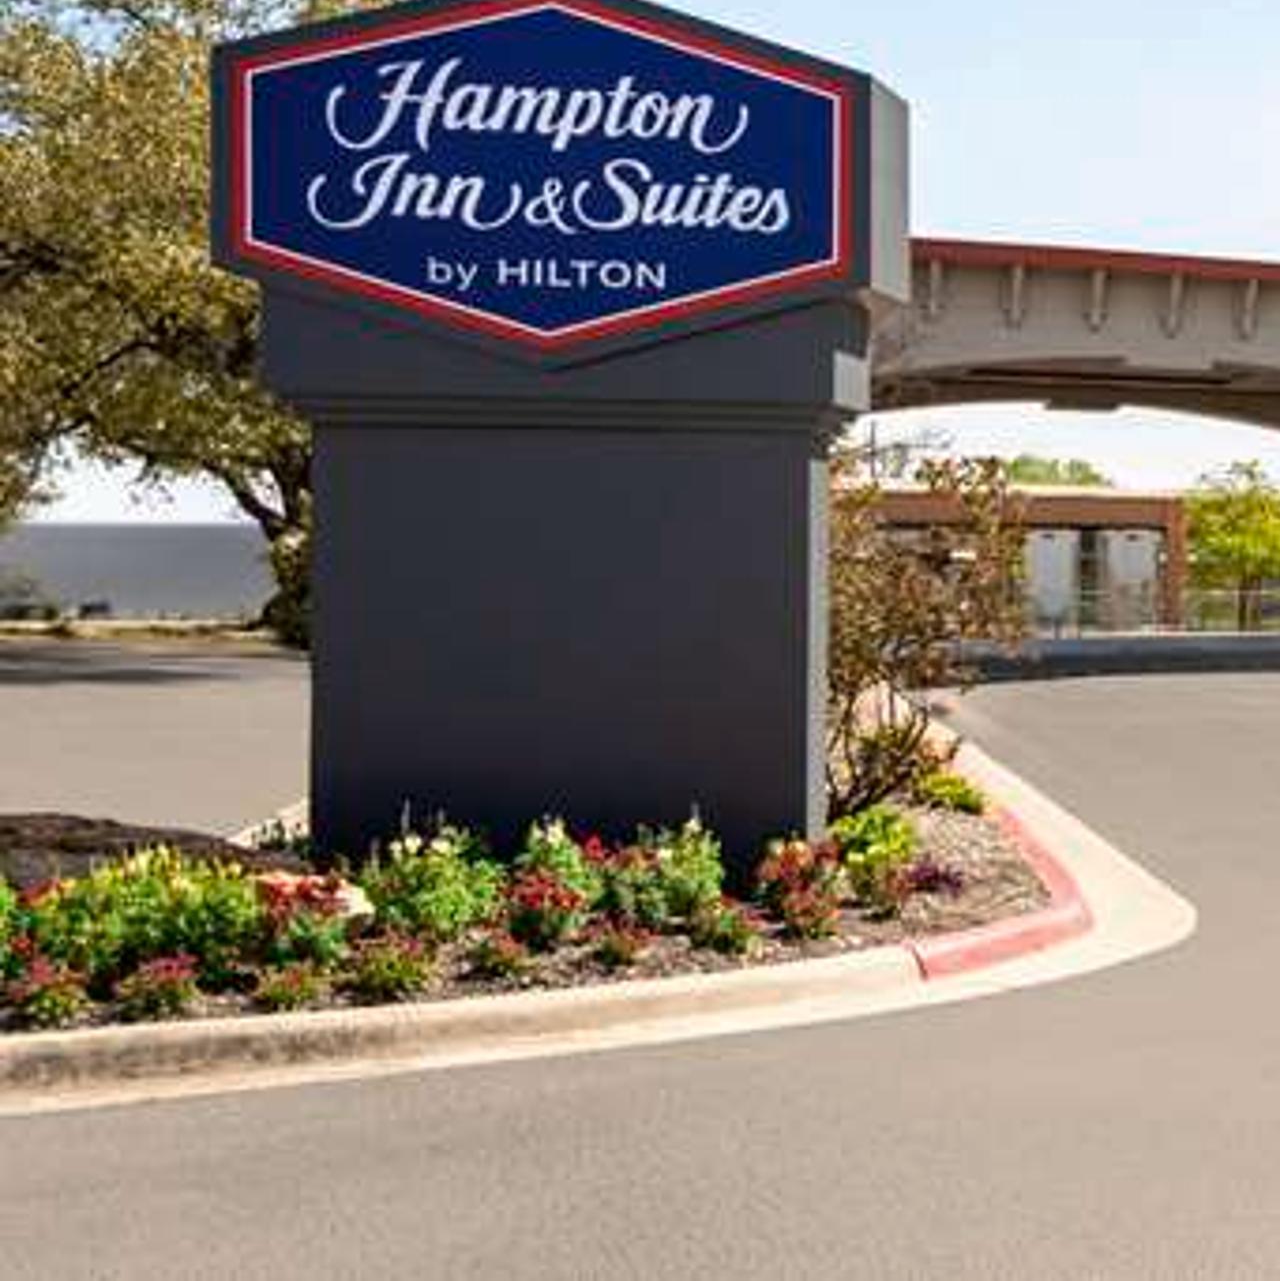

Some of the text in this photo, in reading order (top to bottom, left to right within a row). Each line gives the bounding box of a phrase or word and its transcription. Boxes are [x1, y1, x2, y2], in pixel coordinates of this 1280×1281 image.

[326, 58, 749, 154] Hampton
[307, 153, 522, 231] Inn
[572, 158, 790, 234] Suites
[427, 258, 667, 291] by HILTON
